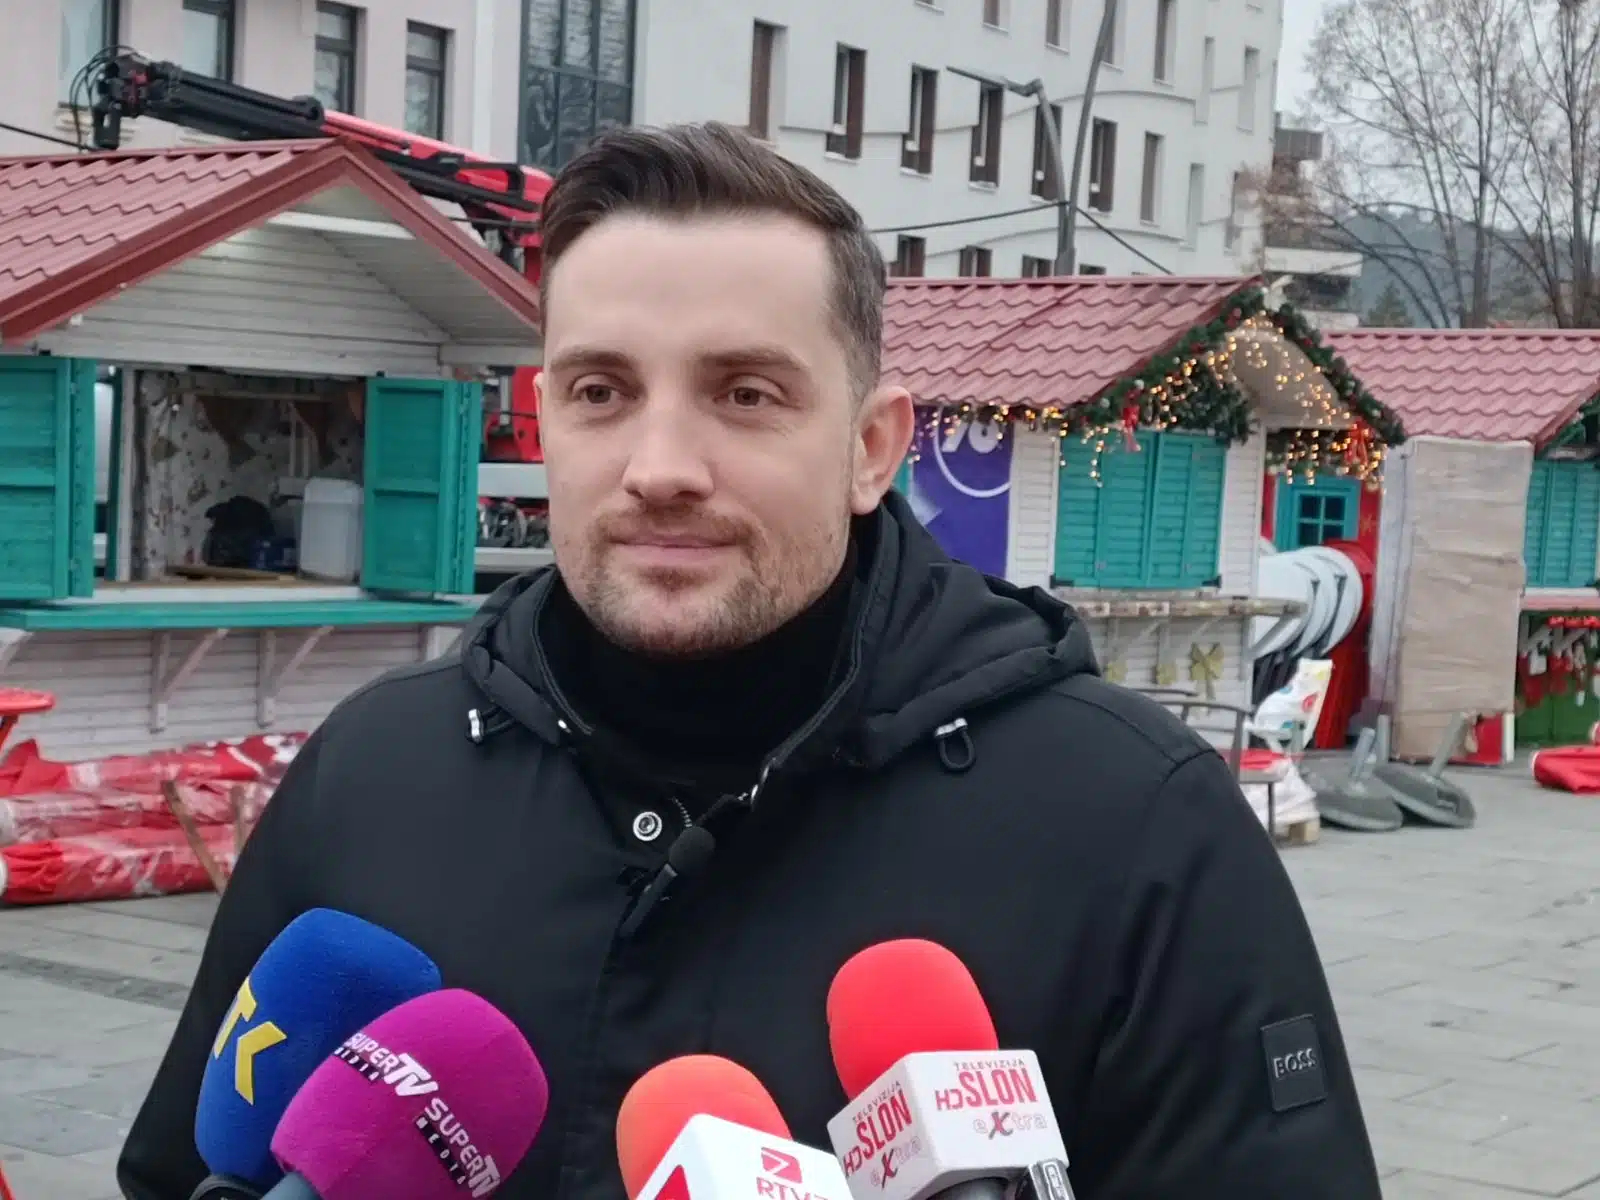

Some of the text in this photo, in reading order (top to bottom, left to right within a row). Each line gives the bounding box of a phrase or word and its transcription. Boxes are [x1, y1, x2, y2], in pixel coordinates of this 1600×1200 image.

[1273, 1047, 1316, 1079] BOSS
[958, 1067, 1038, 1108] SLON
[856, 1089, 913, 1160] SLON
